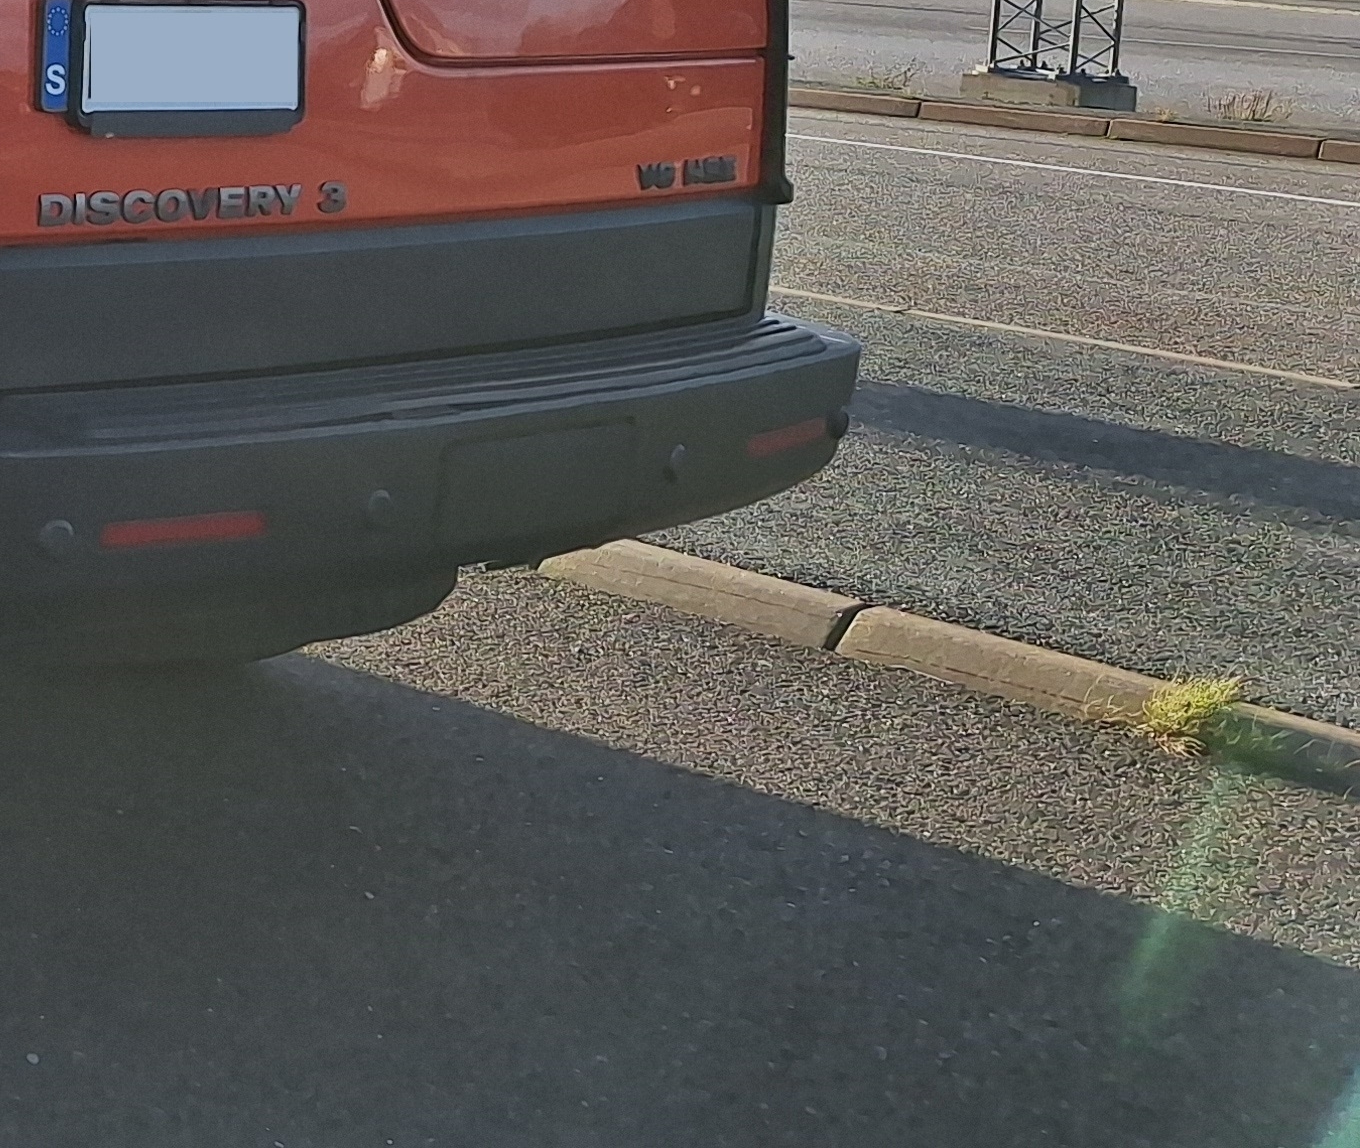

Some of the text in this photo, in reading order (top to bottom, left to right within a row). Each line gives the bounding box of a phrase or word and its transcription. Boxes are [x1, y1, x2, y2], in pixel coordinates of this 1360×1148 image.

[45, 63, 66, 96] S
[38, 180, 347, 228] DISCOVERY 3
